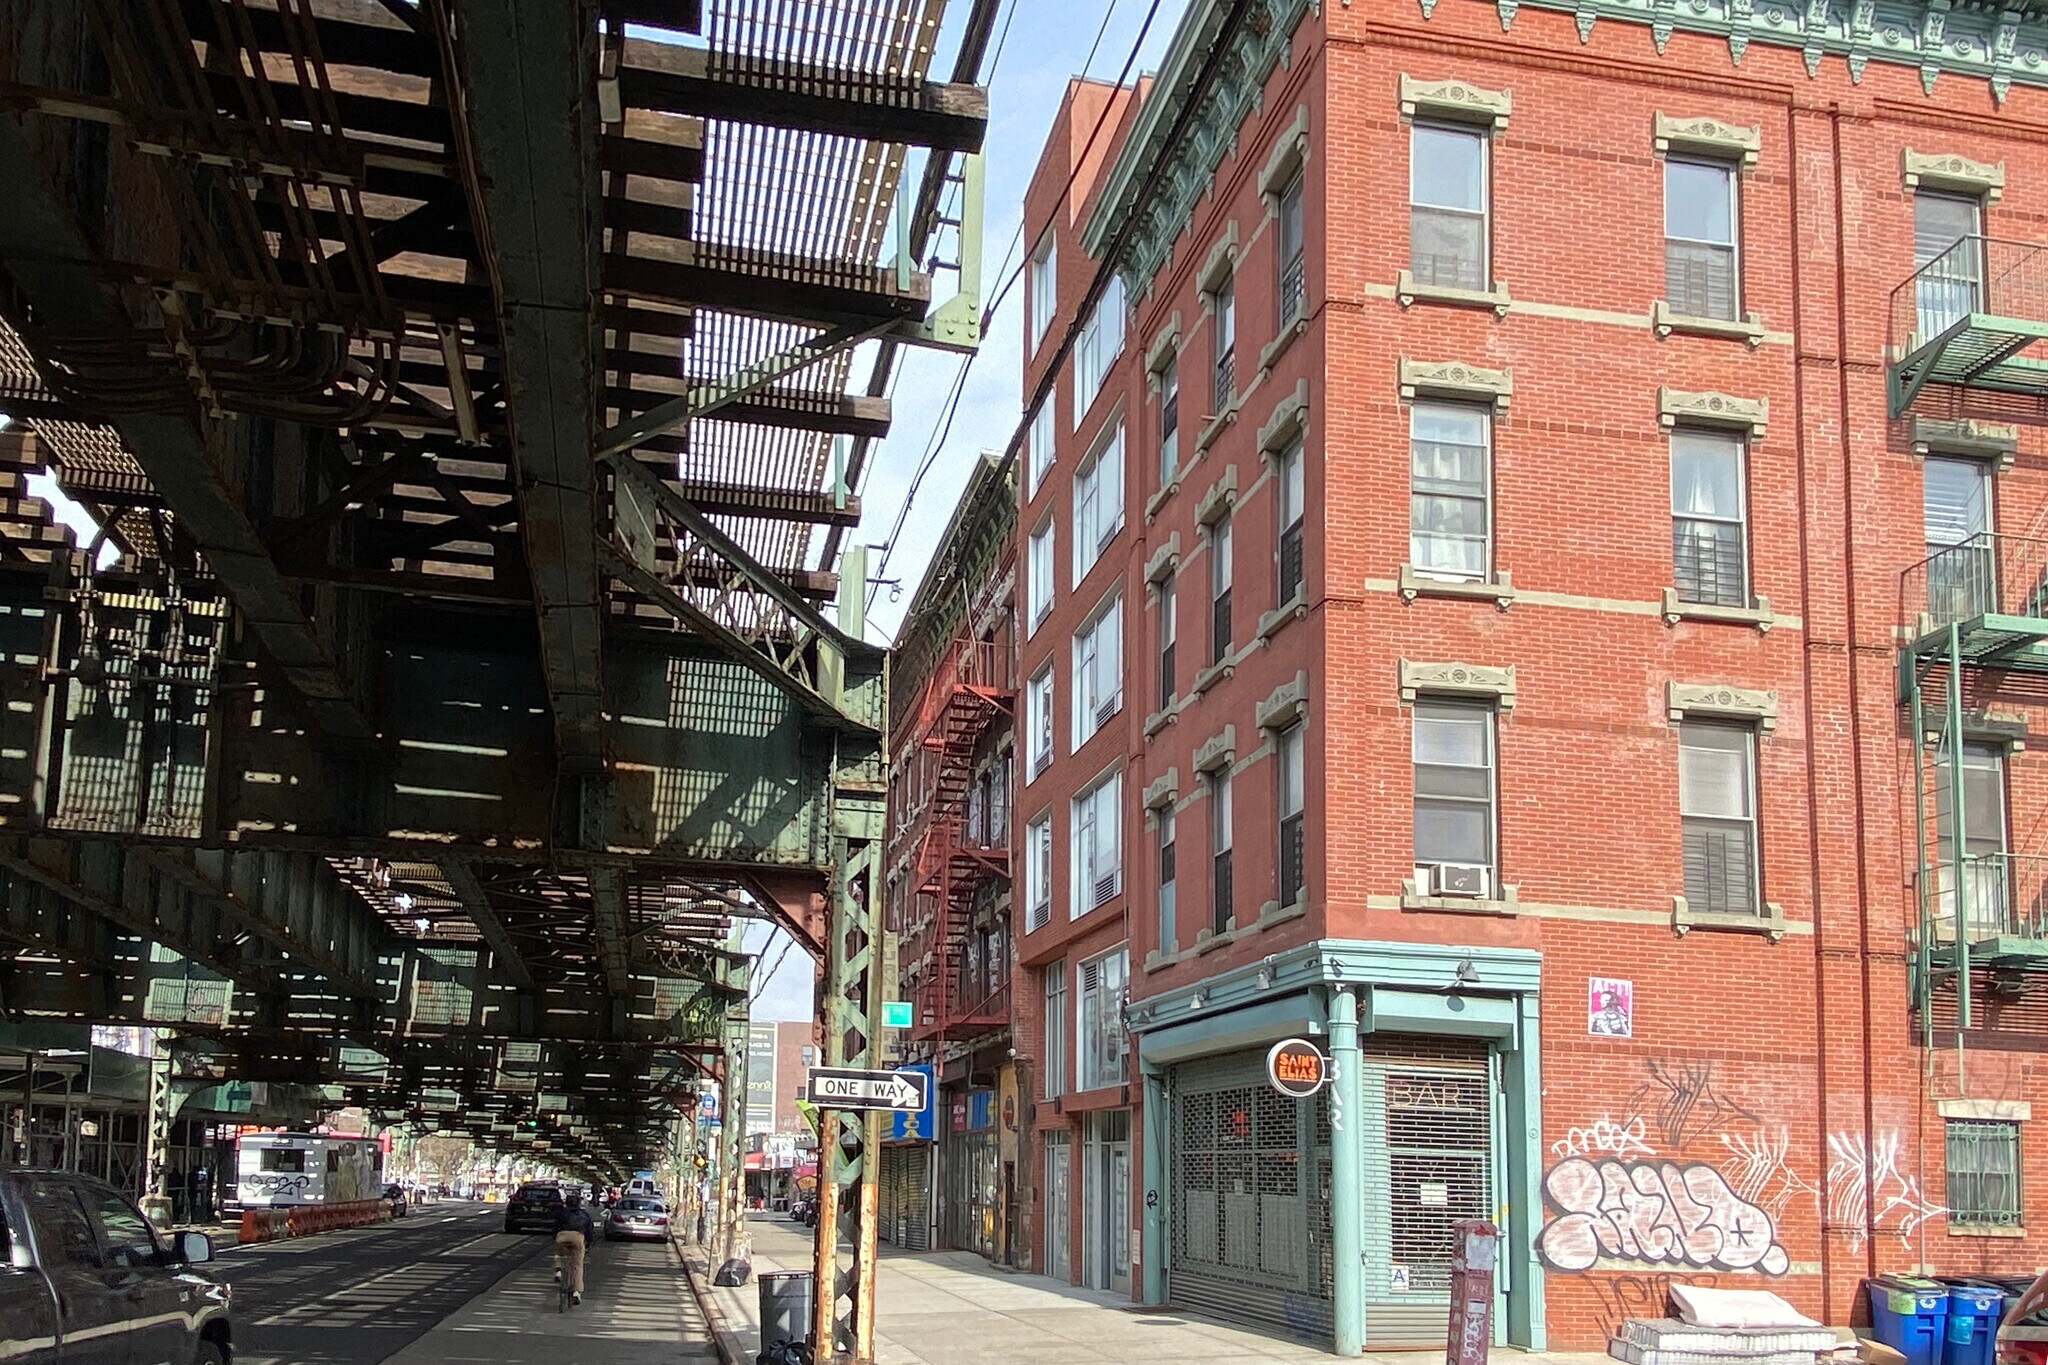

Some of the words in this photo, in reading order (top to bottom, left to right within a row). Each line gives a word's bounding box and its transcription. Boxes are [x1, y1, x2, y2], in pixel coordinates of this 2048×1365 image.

[1279, 1052, 1318, 1068] SAINT
[1279, 1065, 1318, 1080] ELIAS
[825, 1080, 859, 1096] ONE
[874, 1083, 908, 1099] WAY
[1392, 1081, 1460, 1108] BAR
[1393, 1268, 1406, 1283] A
